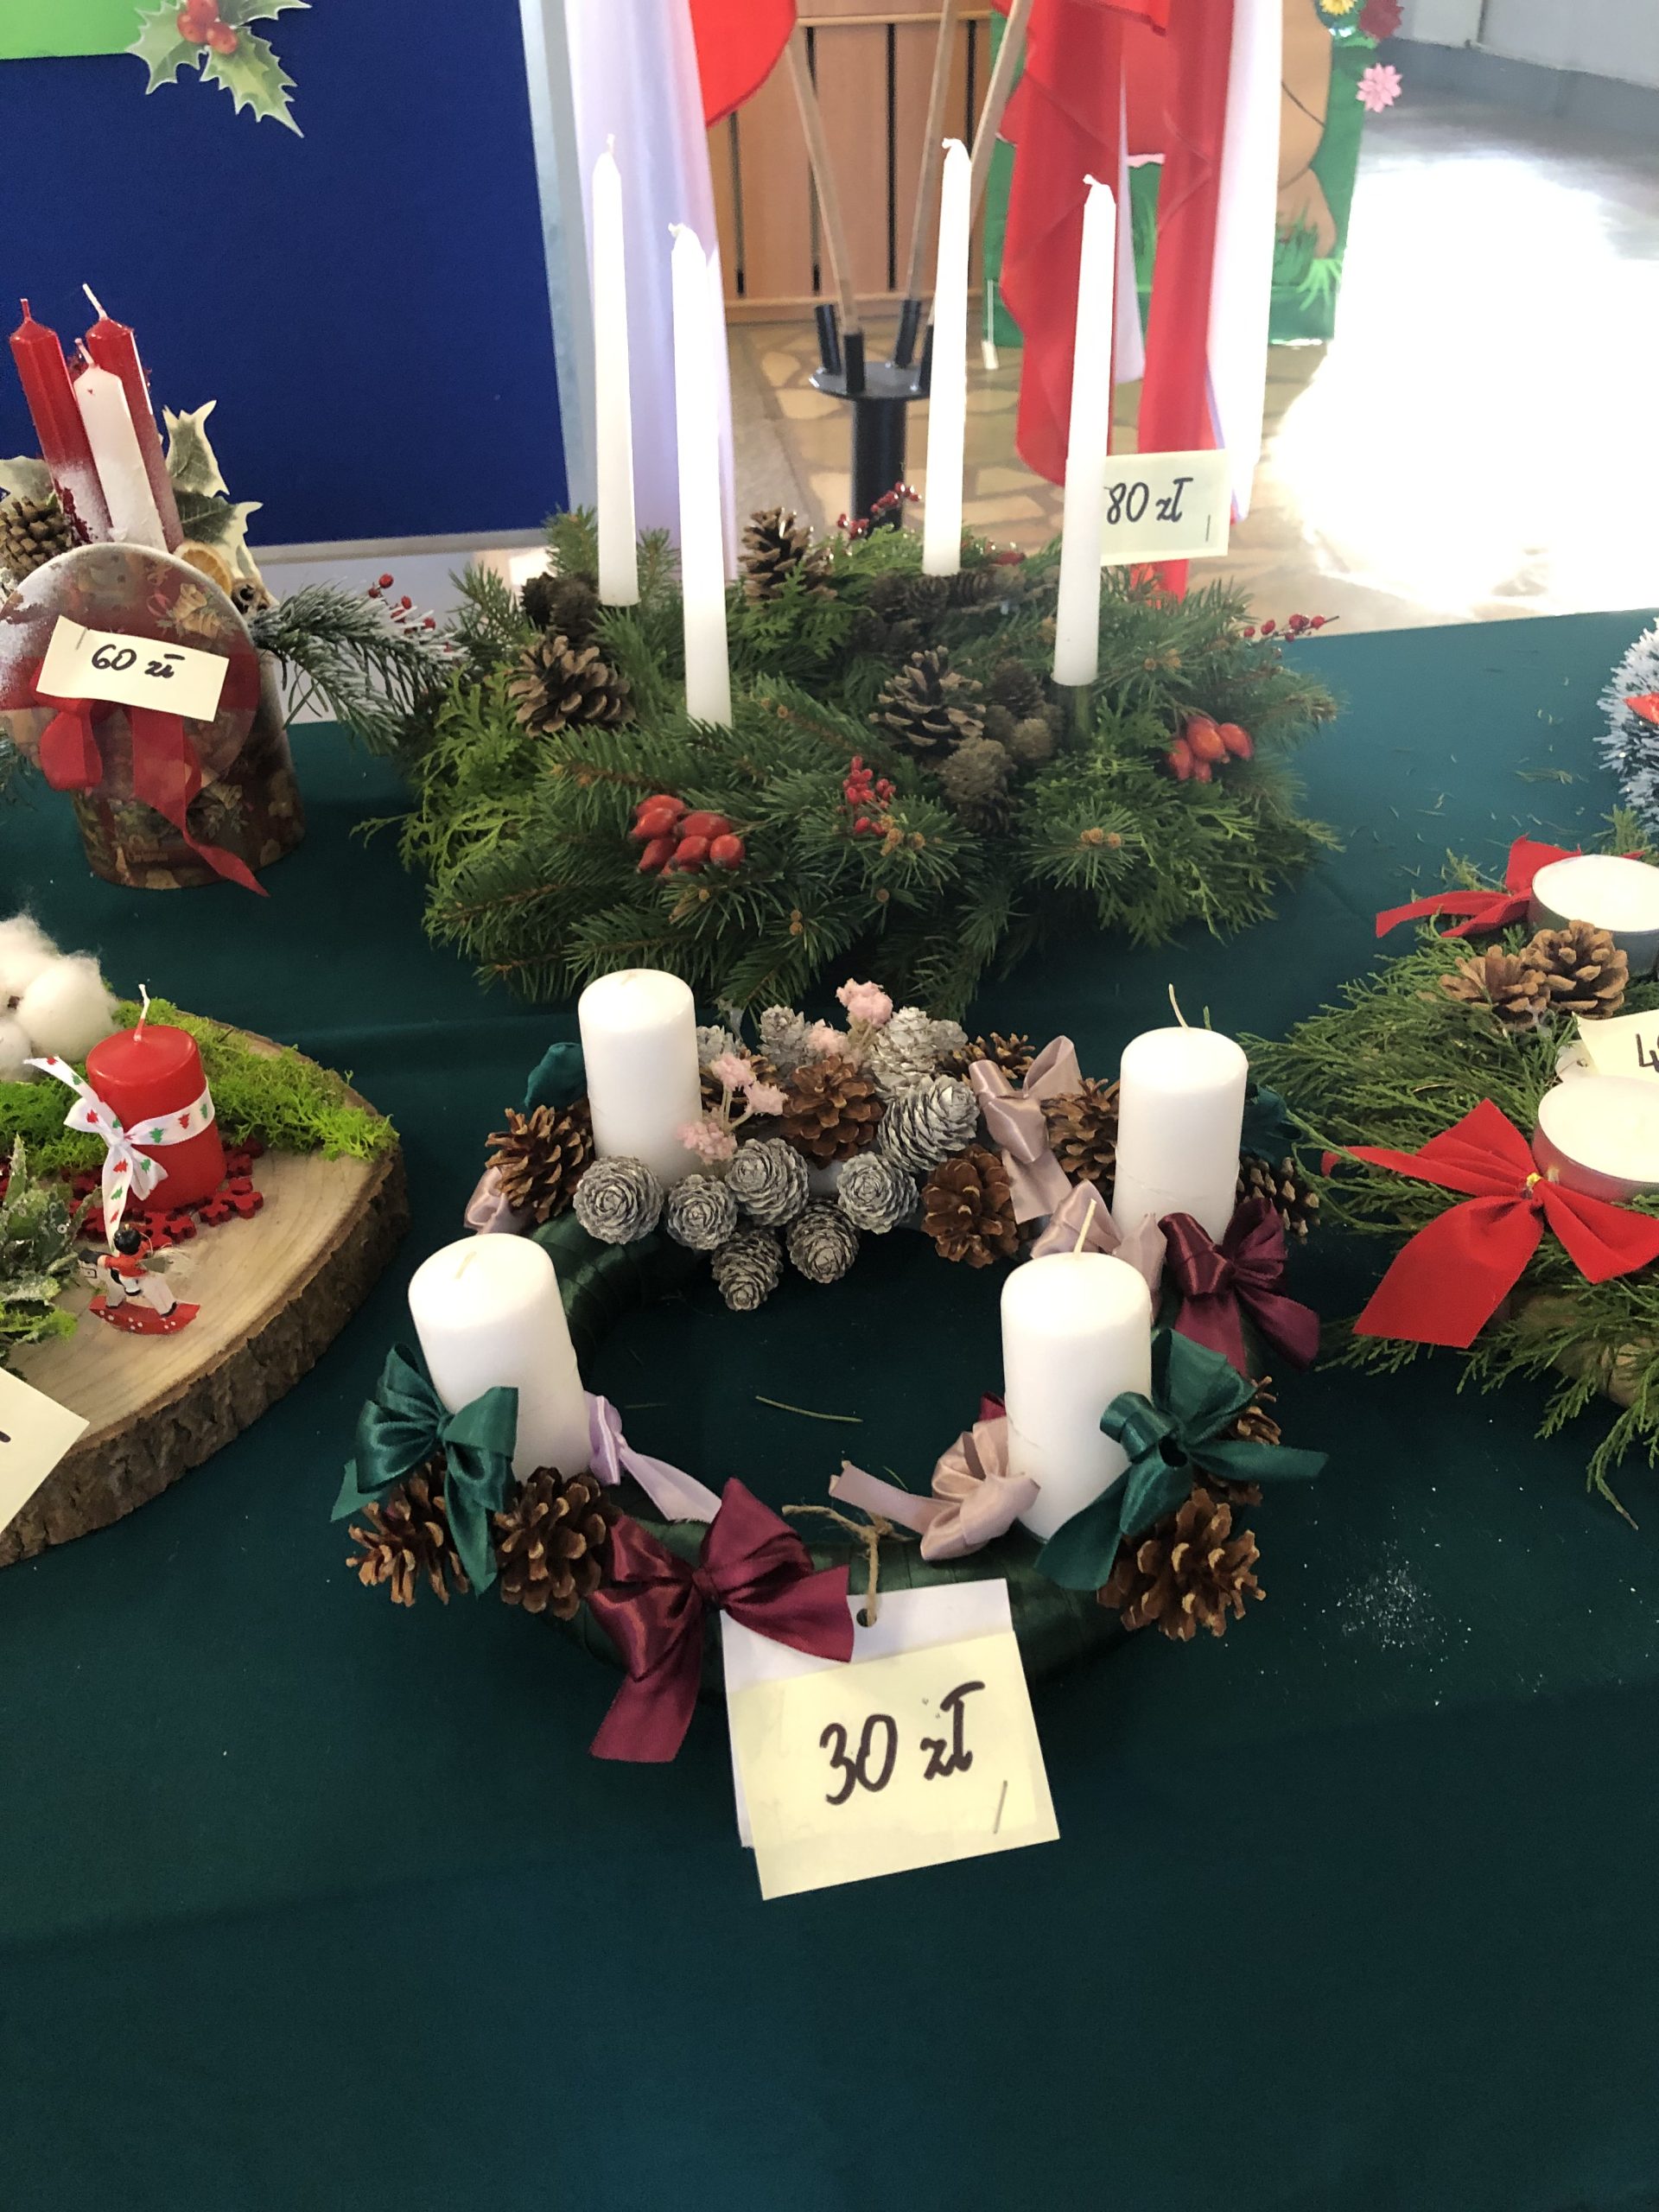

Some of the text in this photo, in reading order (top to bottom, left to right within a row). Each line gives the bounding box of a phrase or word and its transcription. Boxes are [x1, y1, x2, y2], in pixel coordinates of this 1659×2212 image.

[1106, 477, 1193, 524] 80 zł
[91, 644, 186, 678] 60 zł
[819, 1681, 985, 1805] 30 zł
